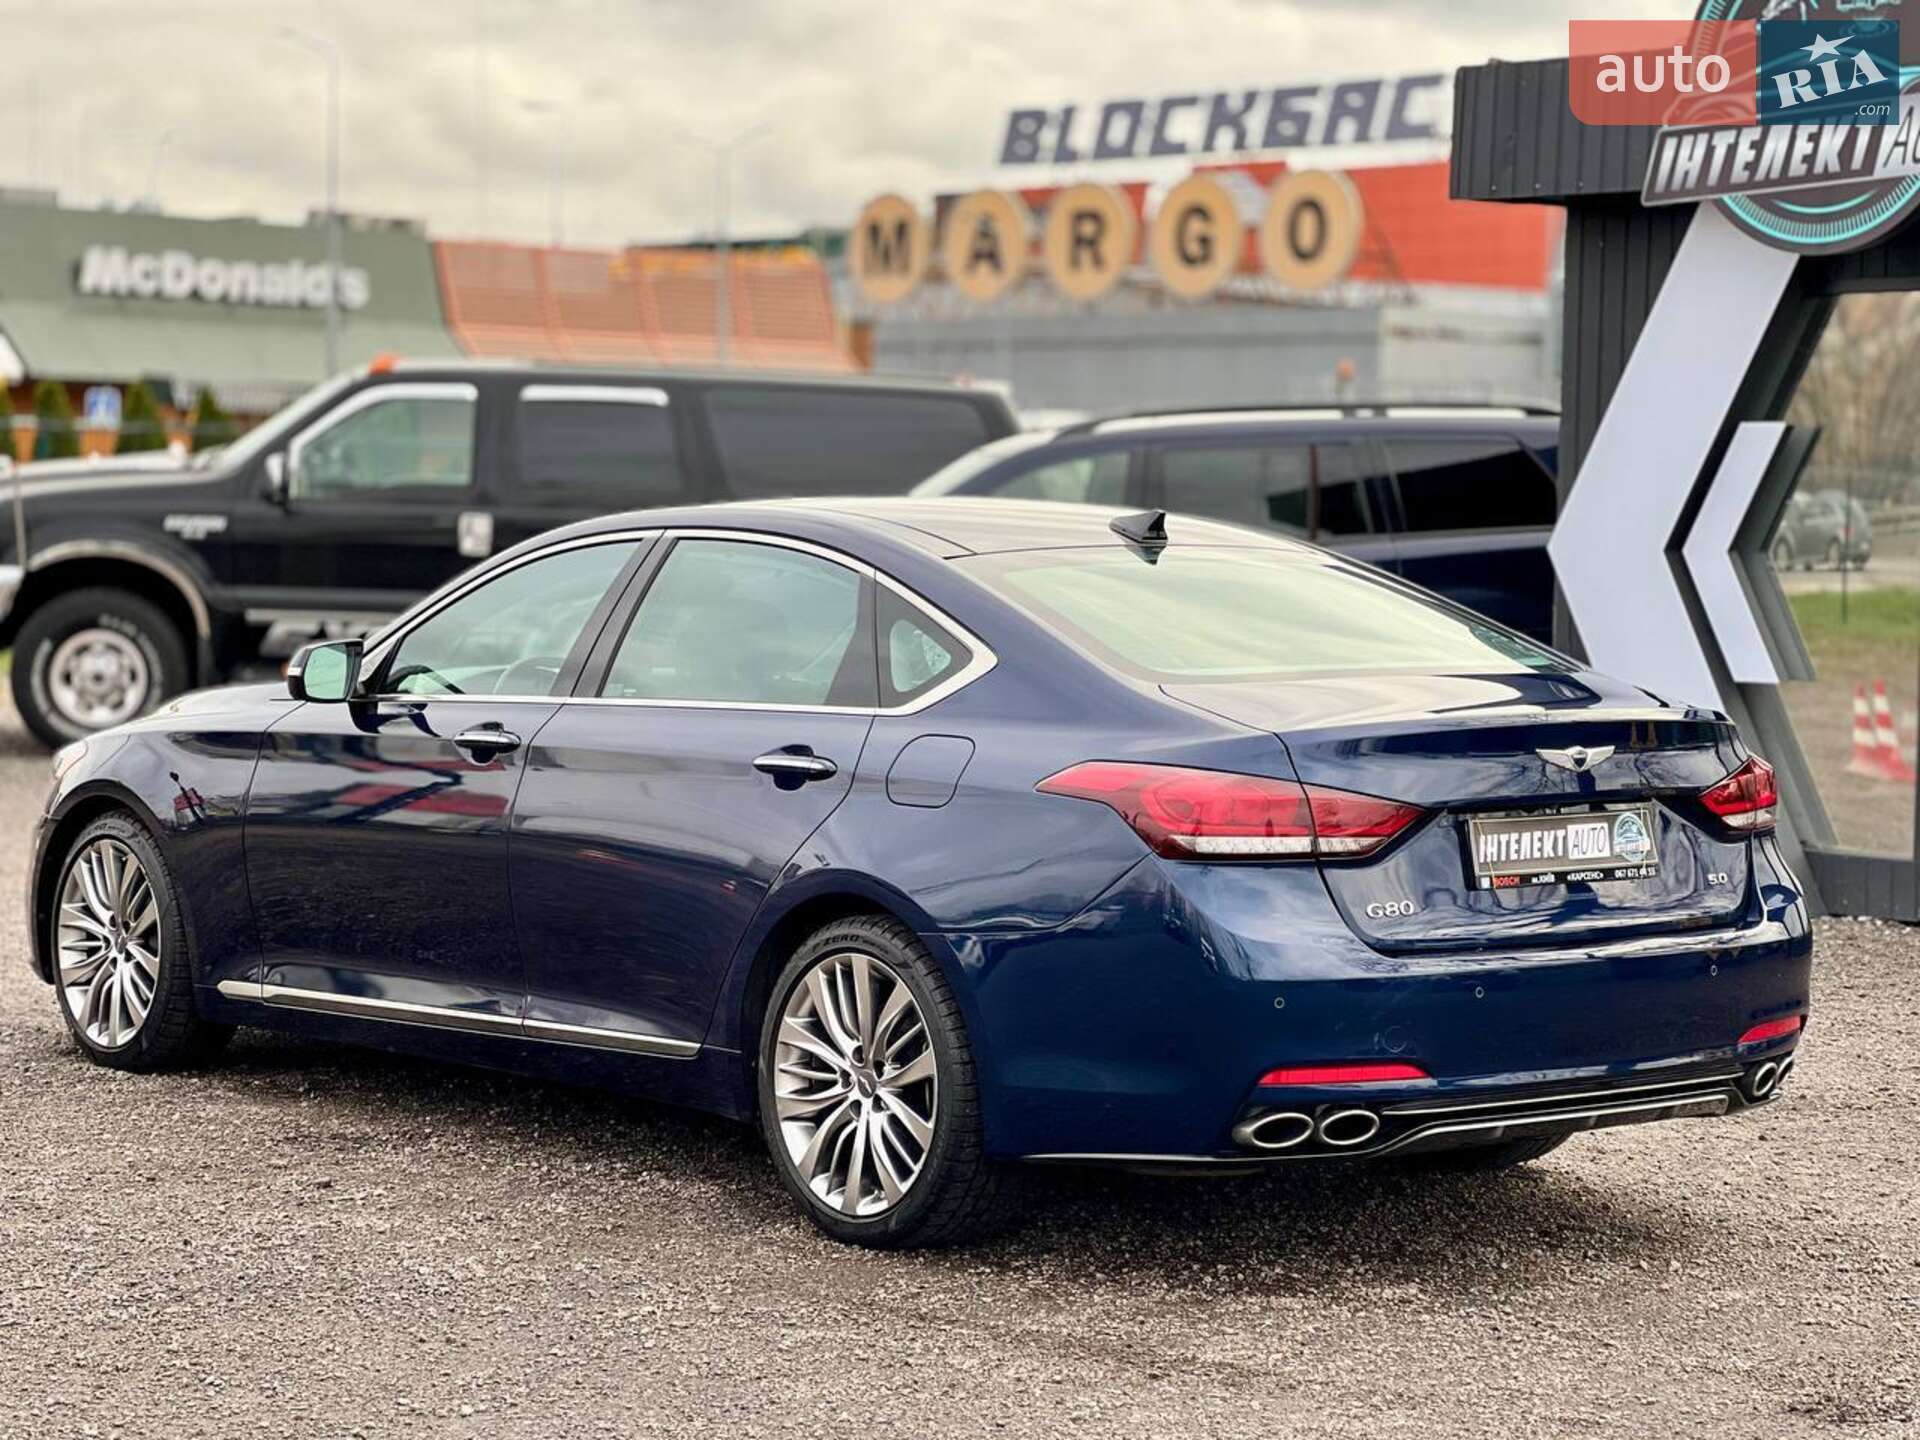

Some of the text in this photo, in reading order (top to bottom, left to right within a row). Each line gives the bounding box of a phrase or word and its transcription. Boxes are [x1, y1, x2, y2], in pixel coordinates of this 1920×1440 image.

[867, 199, 1329, 277] MARGO
[1479, 829, 1566, 864] ІНТЕЛЕКТ
[1570, 825, 1606, 857] AUTO
[1493, 875, 1520, 887] BOSCH
[1366, 900, 1415, 919] G80
